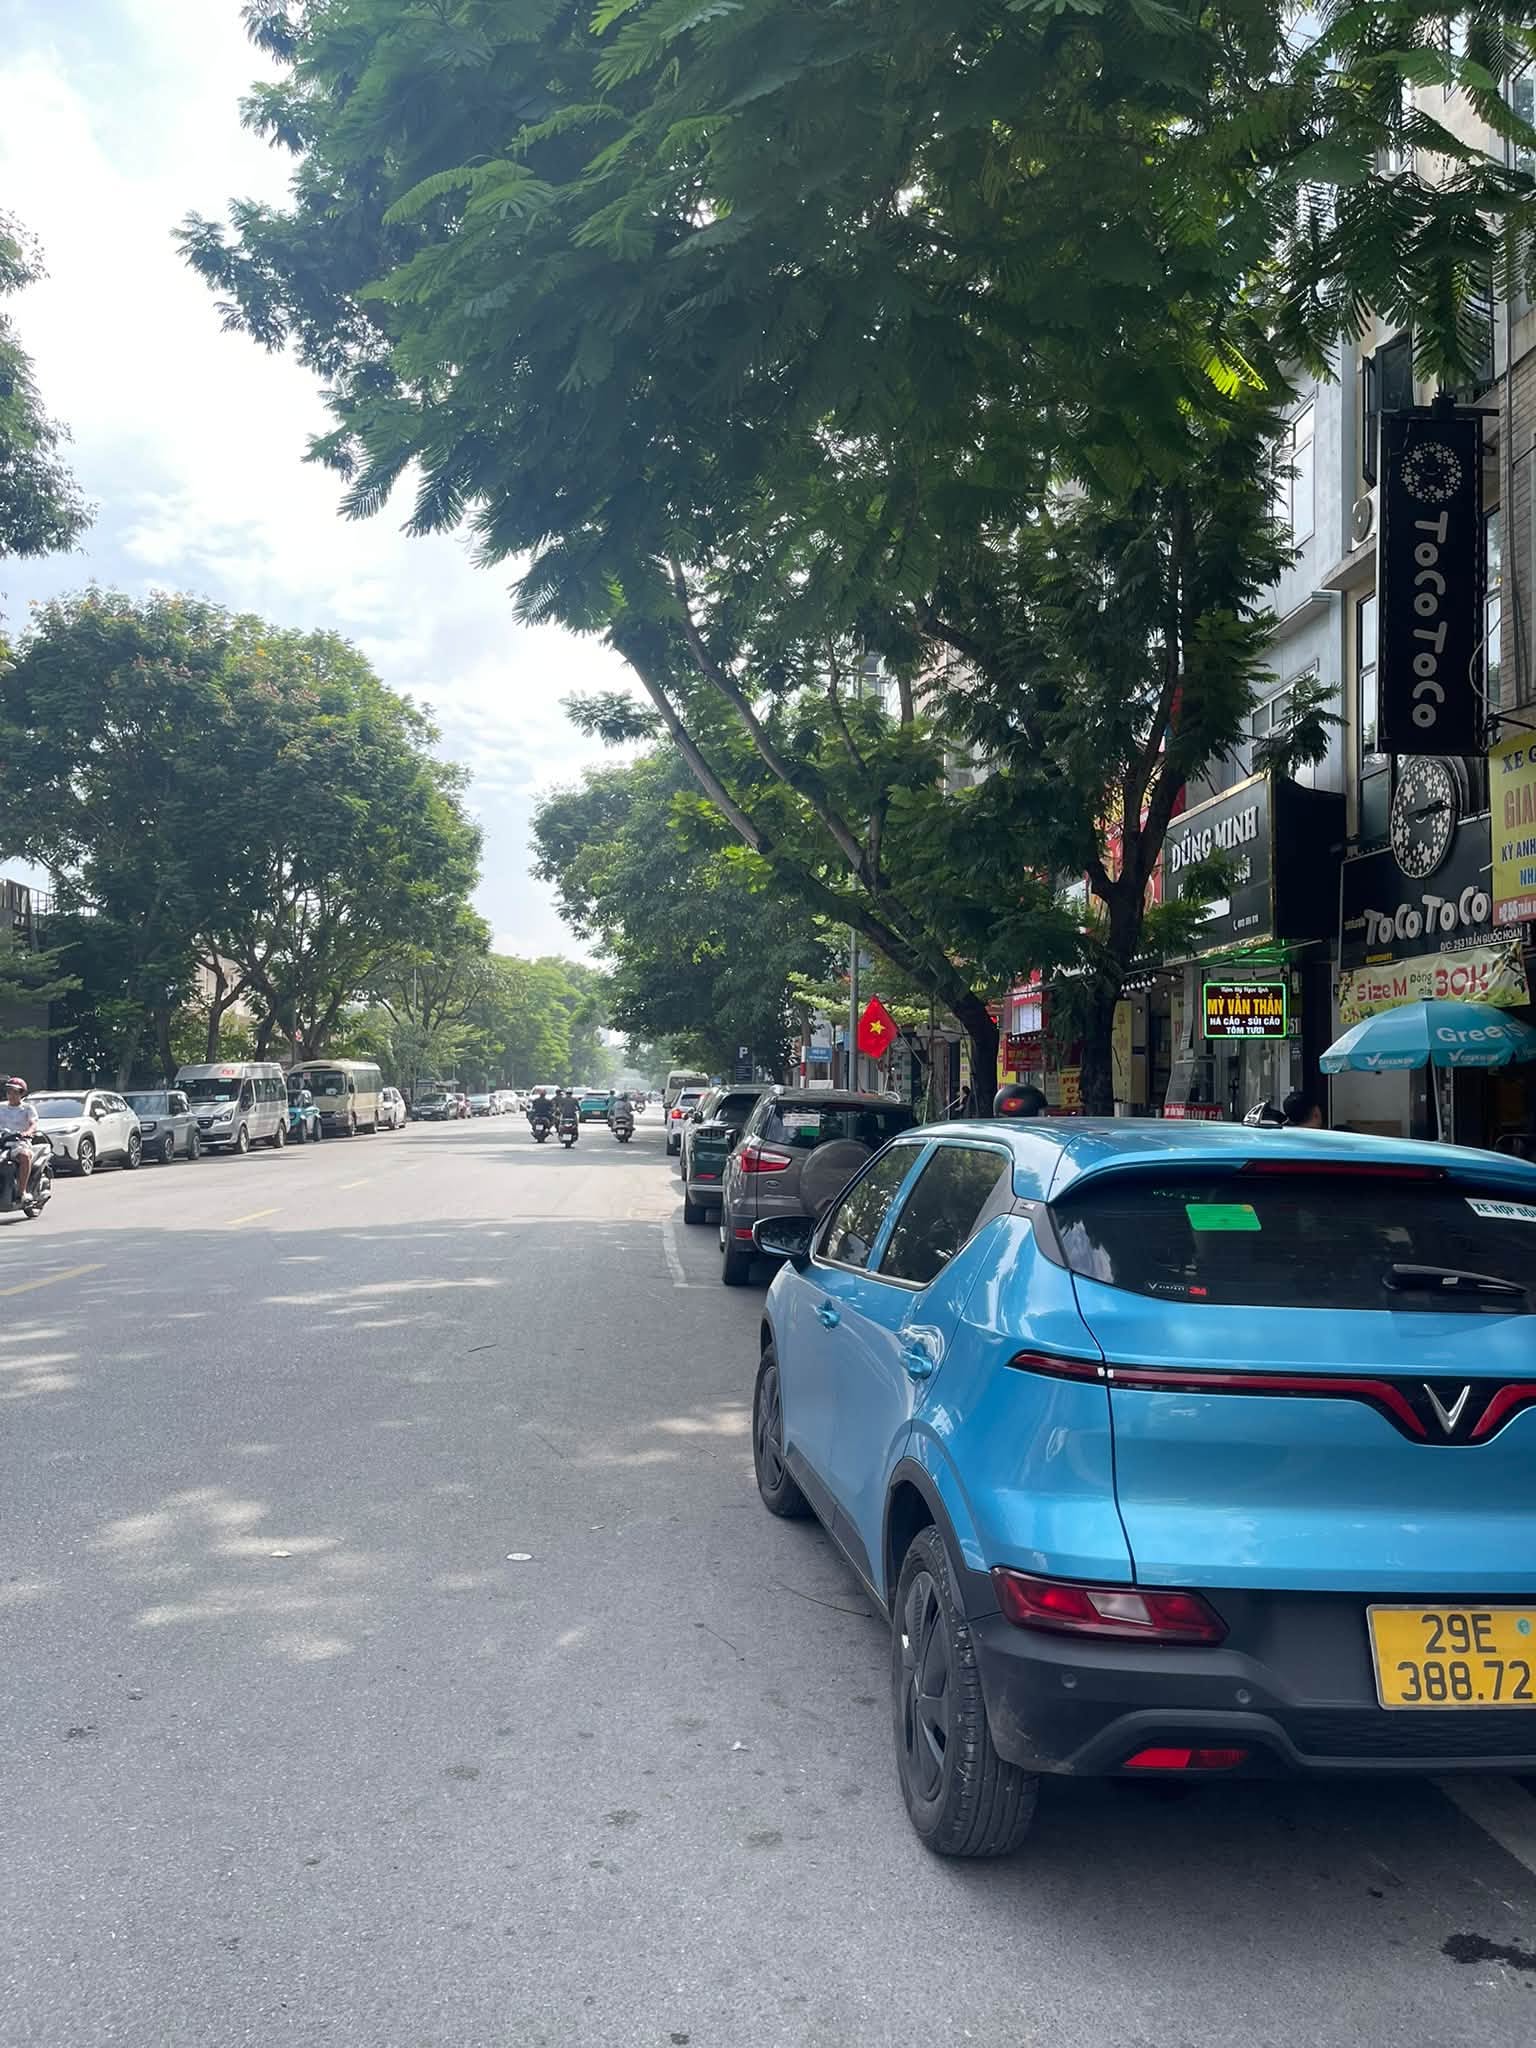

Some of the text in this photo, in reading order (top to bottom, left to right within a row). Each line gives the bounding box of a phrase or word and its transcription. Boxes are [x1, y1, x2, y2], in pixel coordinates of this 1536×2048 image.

[1502, 751, 1524, 774] XE
[1171, 828, 1212, 873] DŨNG
[1214, 806, 1258, 849] MINH
[1364, 886, 1491, 945] ToCoToCo
[1435, 964, 1489, 997] 30K
[1207, 995, 1225, 1015] MỲ
[738, 1046, 749, 1059] P
[1473, 1203, 1491, 1213] XE
[1421, 1613, 1497, 1654] 29E
[1397, 1660, 1533, 1701] 388.72
